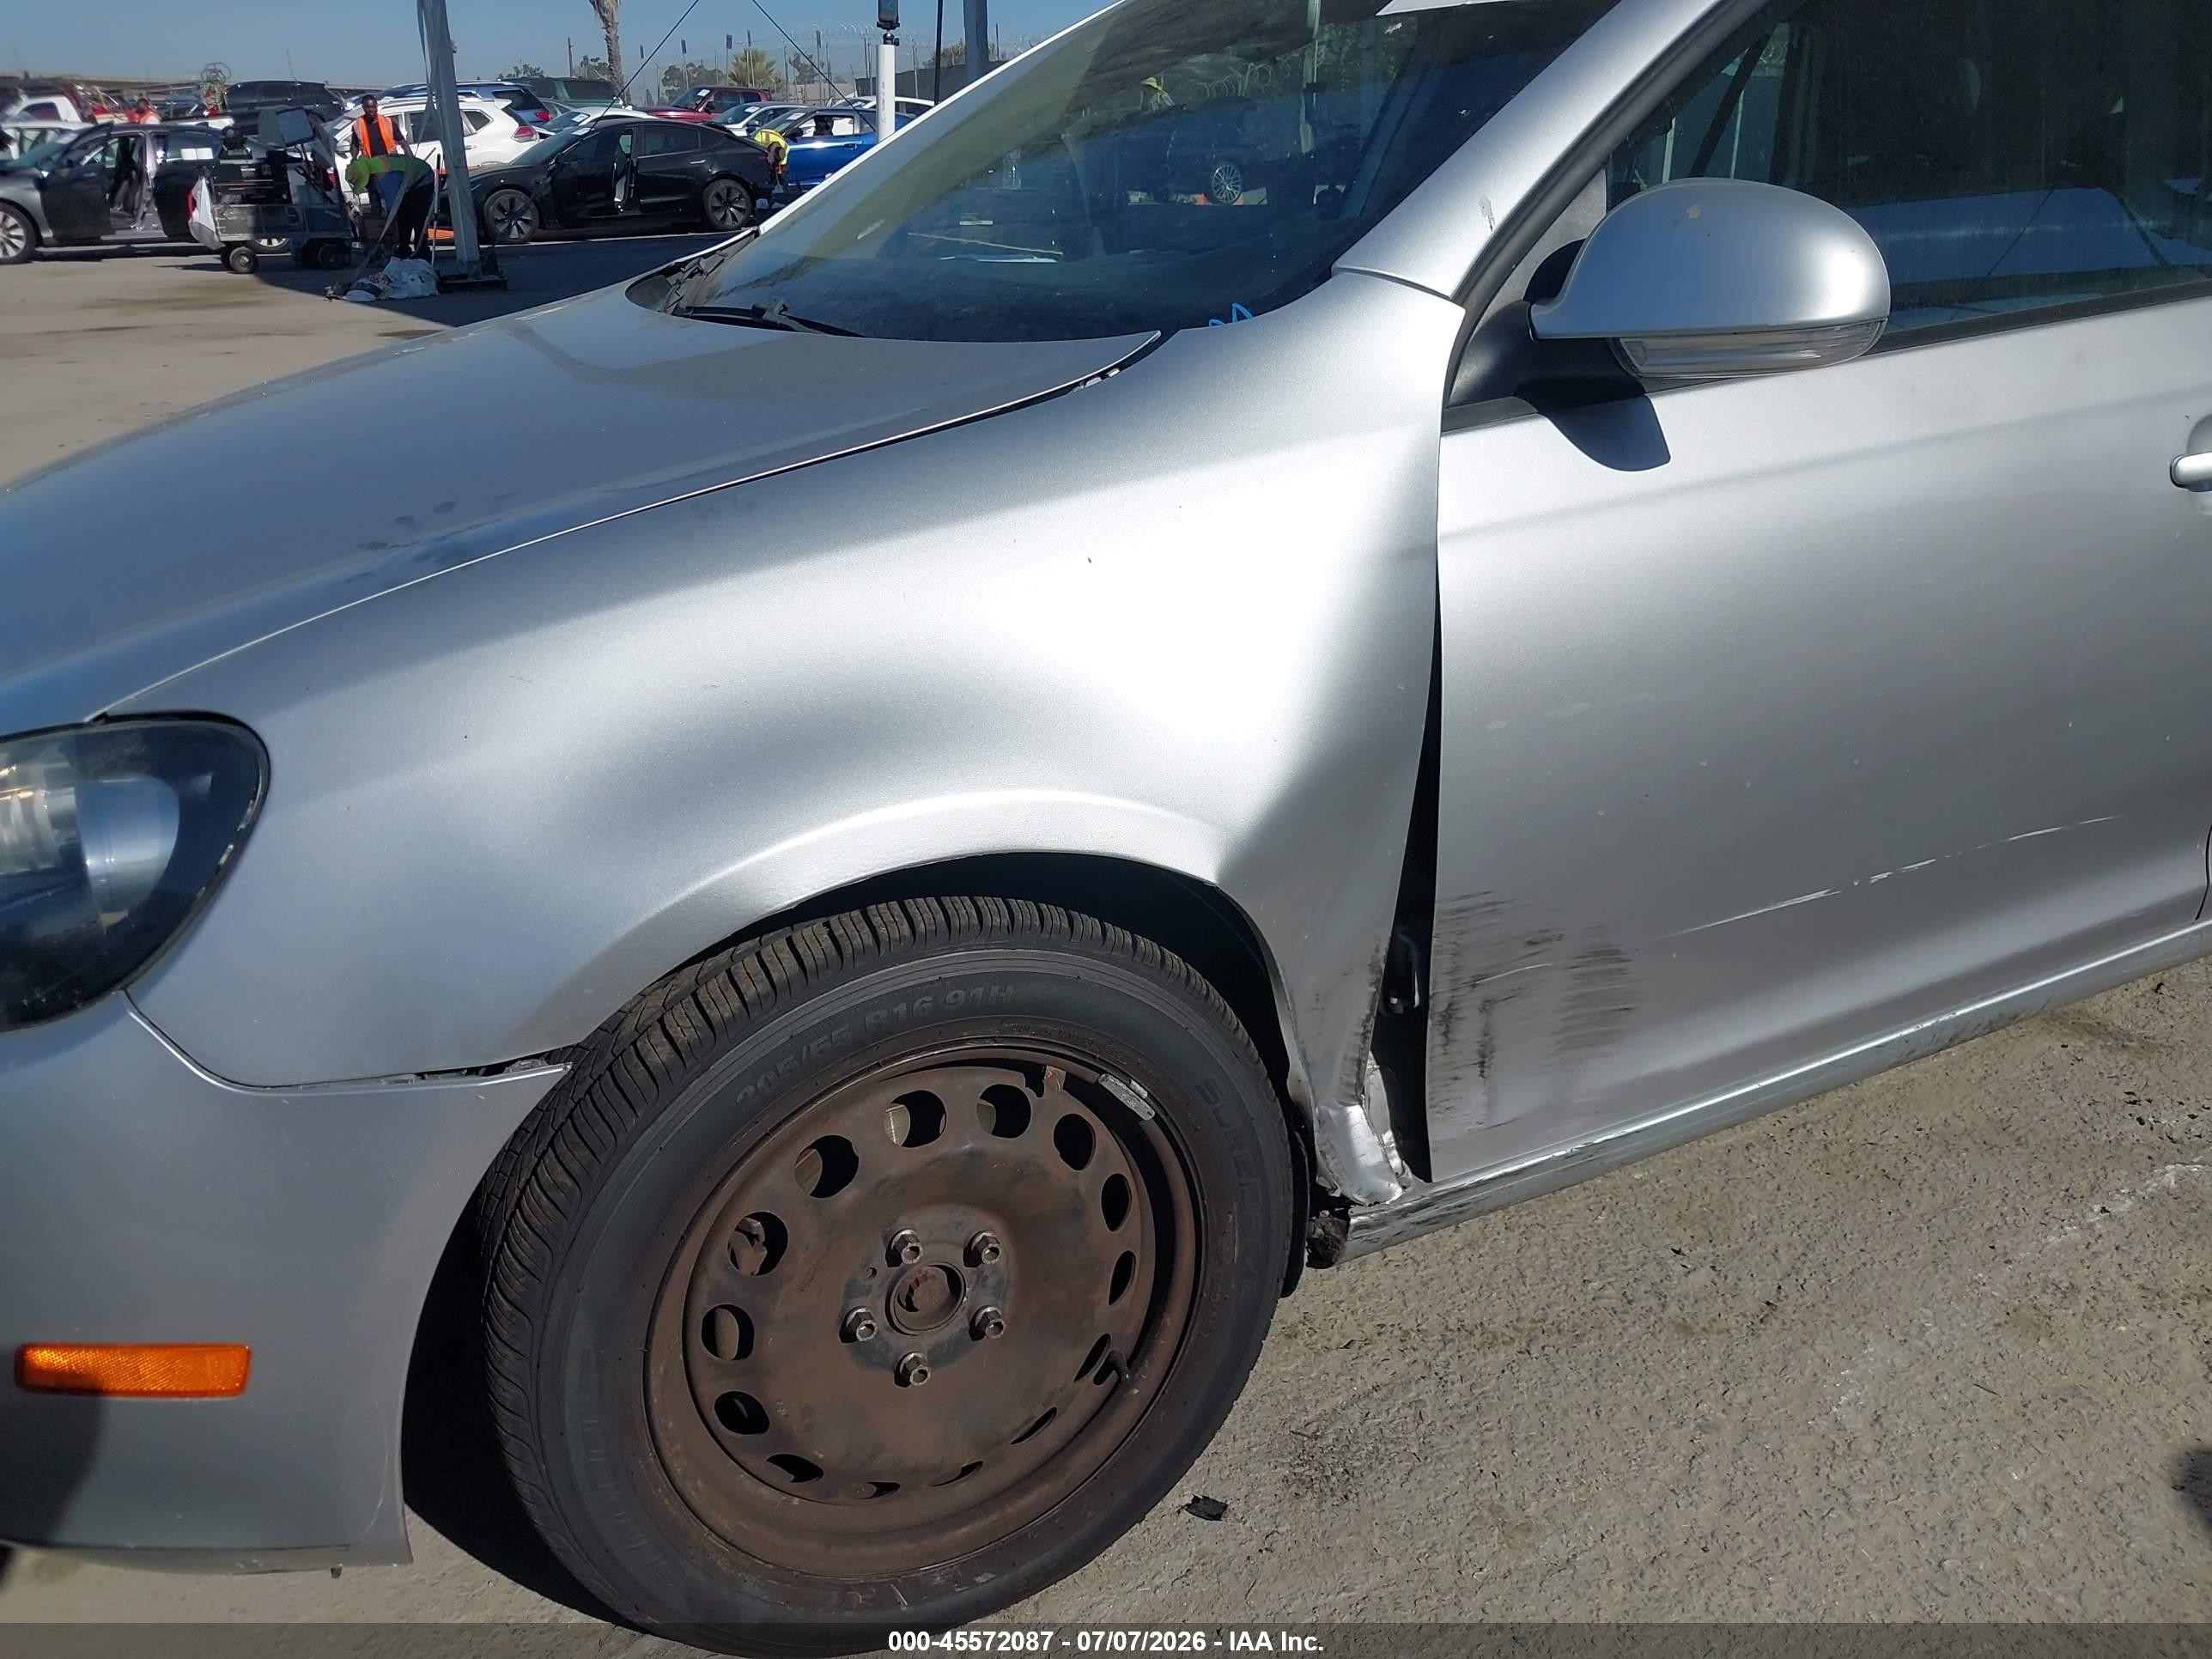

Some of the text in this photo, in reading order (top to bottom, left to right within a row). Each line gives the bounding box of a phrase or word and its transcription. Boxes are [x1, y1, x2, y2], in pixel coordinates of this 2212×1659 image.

[735, 984, 1016, 1109] 205/55 R16 91H
